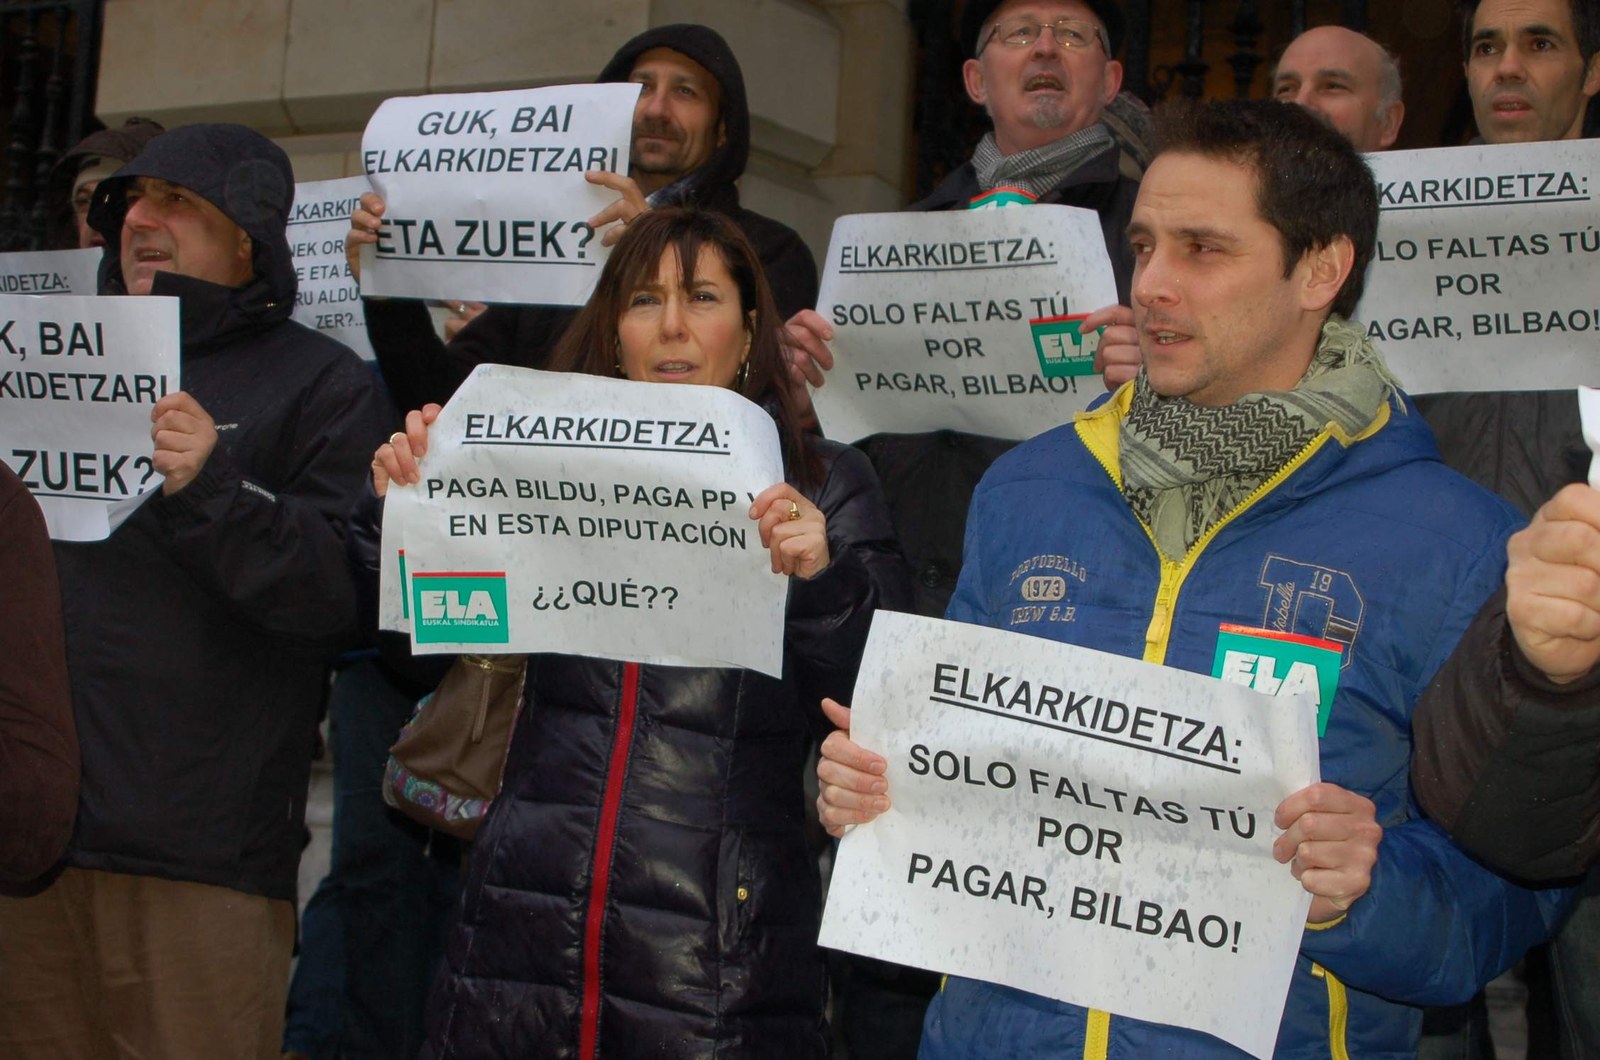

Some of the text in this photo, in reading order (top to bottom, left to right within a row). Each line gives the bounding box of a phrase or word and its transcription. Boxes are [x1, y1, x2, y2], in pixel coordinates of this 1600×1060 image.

[418, 104, 573, 139] GUK, BAI
[364, 147, 618, 175] ELKARKIDETZARI
[375, 219, 596, 259] ETA ZUEK?
[840, 237, 1055, 268] ELKARKIDETZA:
[1428, 234, 1550, 260] FALTAS
[1559, 226, 1600, 254] TÚ
[0, 272, 69, 292] IDETZA:
[310, 265, 339, 280] ETA
[1436, 273, 1502, 297] POR
[833, 290, 1069, 326] SOLO FALTAS TÚ
[1473, 309, 1600, 336] BILBAO!
[39, 321, 104, 356] BAI
[925, 337, 985, 359] POR
[1039, 329, 1101, 358] ELA
[855, 372, 1078, 398] PAGAR, BILBAO!
[465, 413, 730, 449] ELKARKIDETZA:
[12, 449, 154, 497] ZUEK?
[427, 478, 508, 500] PAGA
[515, 480, 605, 506] BILDU,
[613, 483, 694, 509] PAGA
[702, 489, 737, 511] PP
[449, 513, 747, 550] EN ESTA DIPUTACIÓN
[532, 577, 679, 611] ¿¿QUÉ??
[1026, 579, 1061, 598] 1973
[1309, 570, 1333, 592] 19
[420, 590, 499, 619] ELA
[453, 619, 499, 627] SINDIKATUA
[1221, 649, 1321, 706] ELA
[933, 663, 1242, 764] ELKARKIDETZA:
[908, 744, 1257, 839] SOLO FALTAS TÚ
[1037, 816, 1123, 863] POR
[907, 853, 1243, 954] PAGAR, BILBAO!
